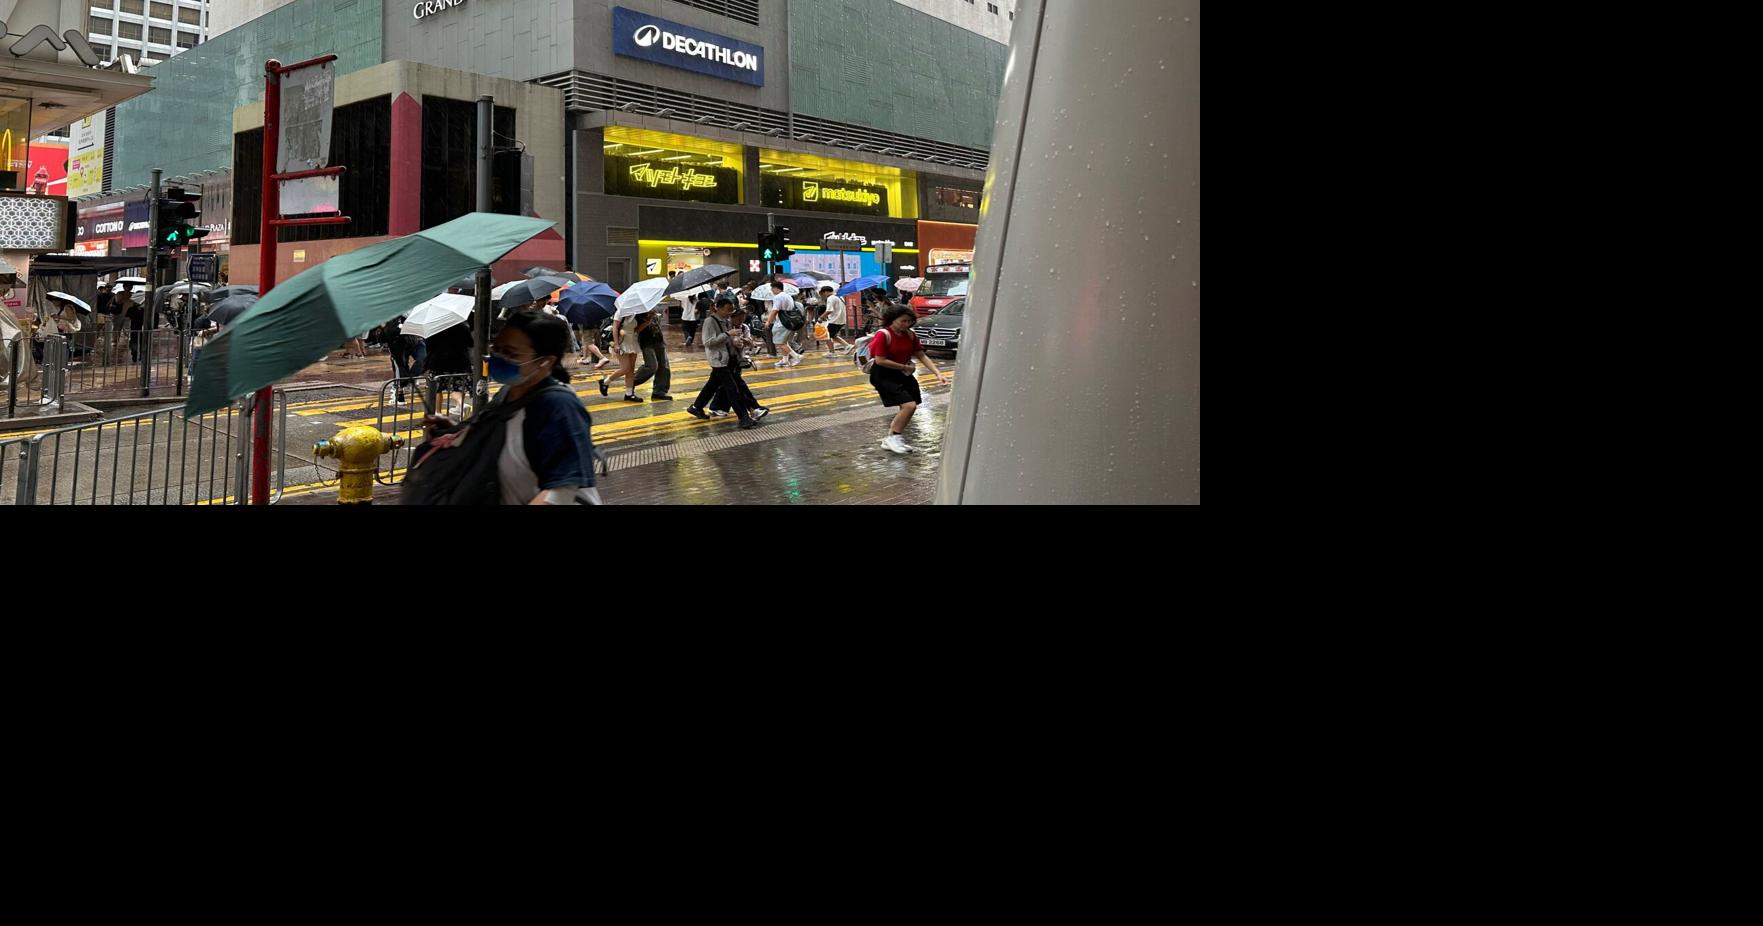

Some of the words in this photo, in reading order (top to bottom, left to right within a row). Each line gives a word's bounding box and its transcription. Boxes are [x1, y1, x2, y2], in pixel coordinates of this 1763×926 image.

[662, 31, 757, 71] DECATHLON
[822, 186, 880, 206] matsukiyo
[95, 222, 118, 233] COTTON
